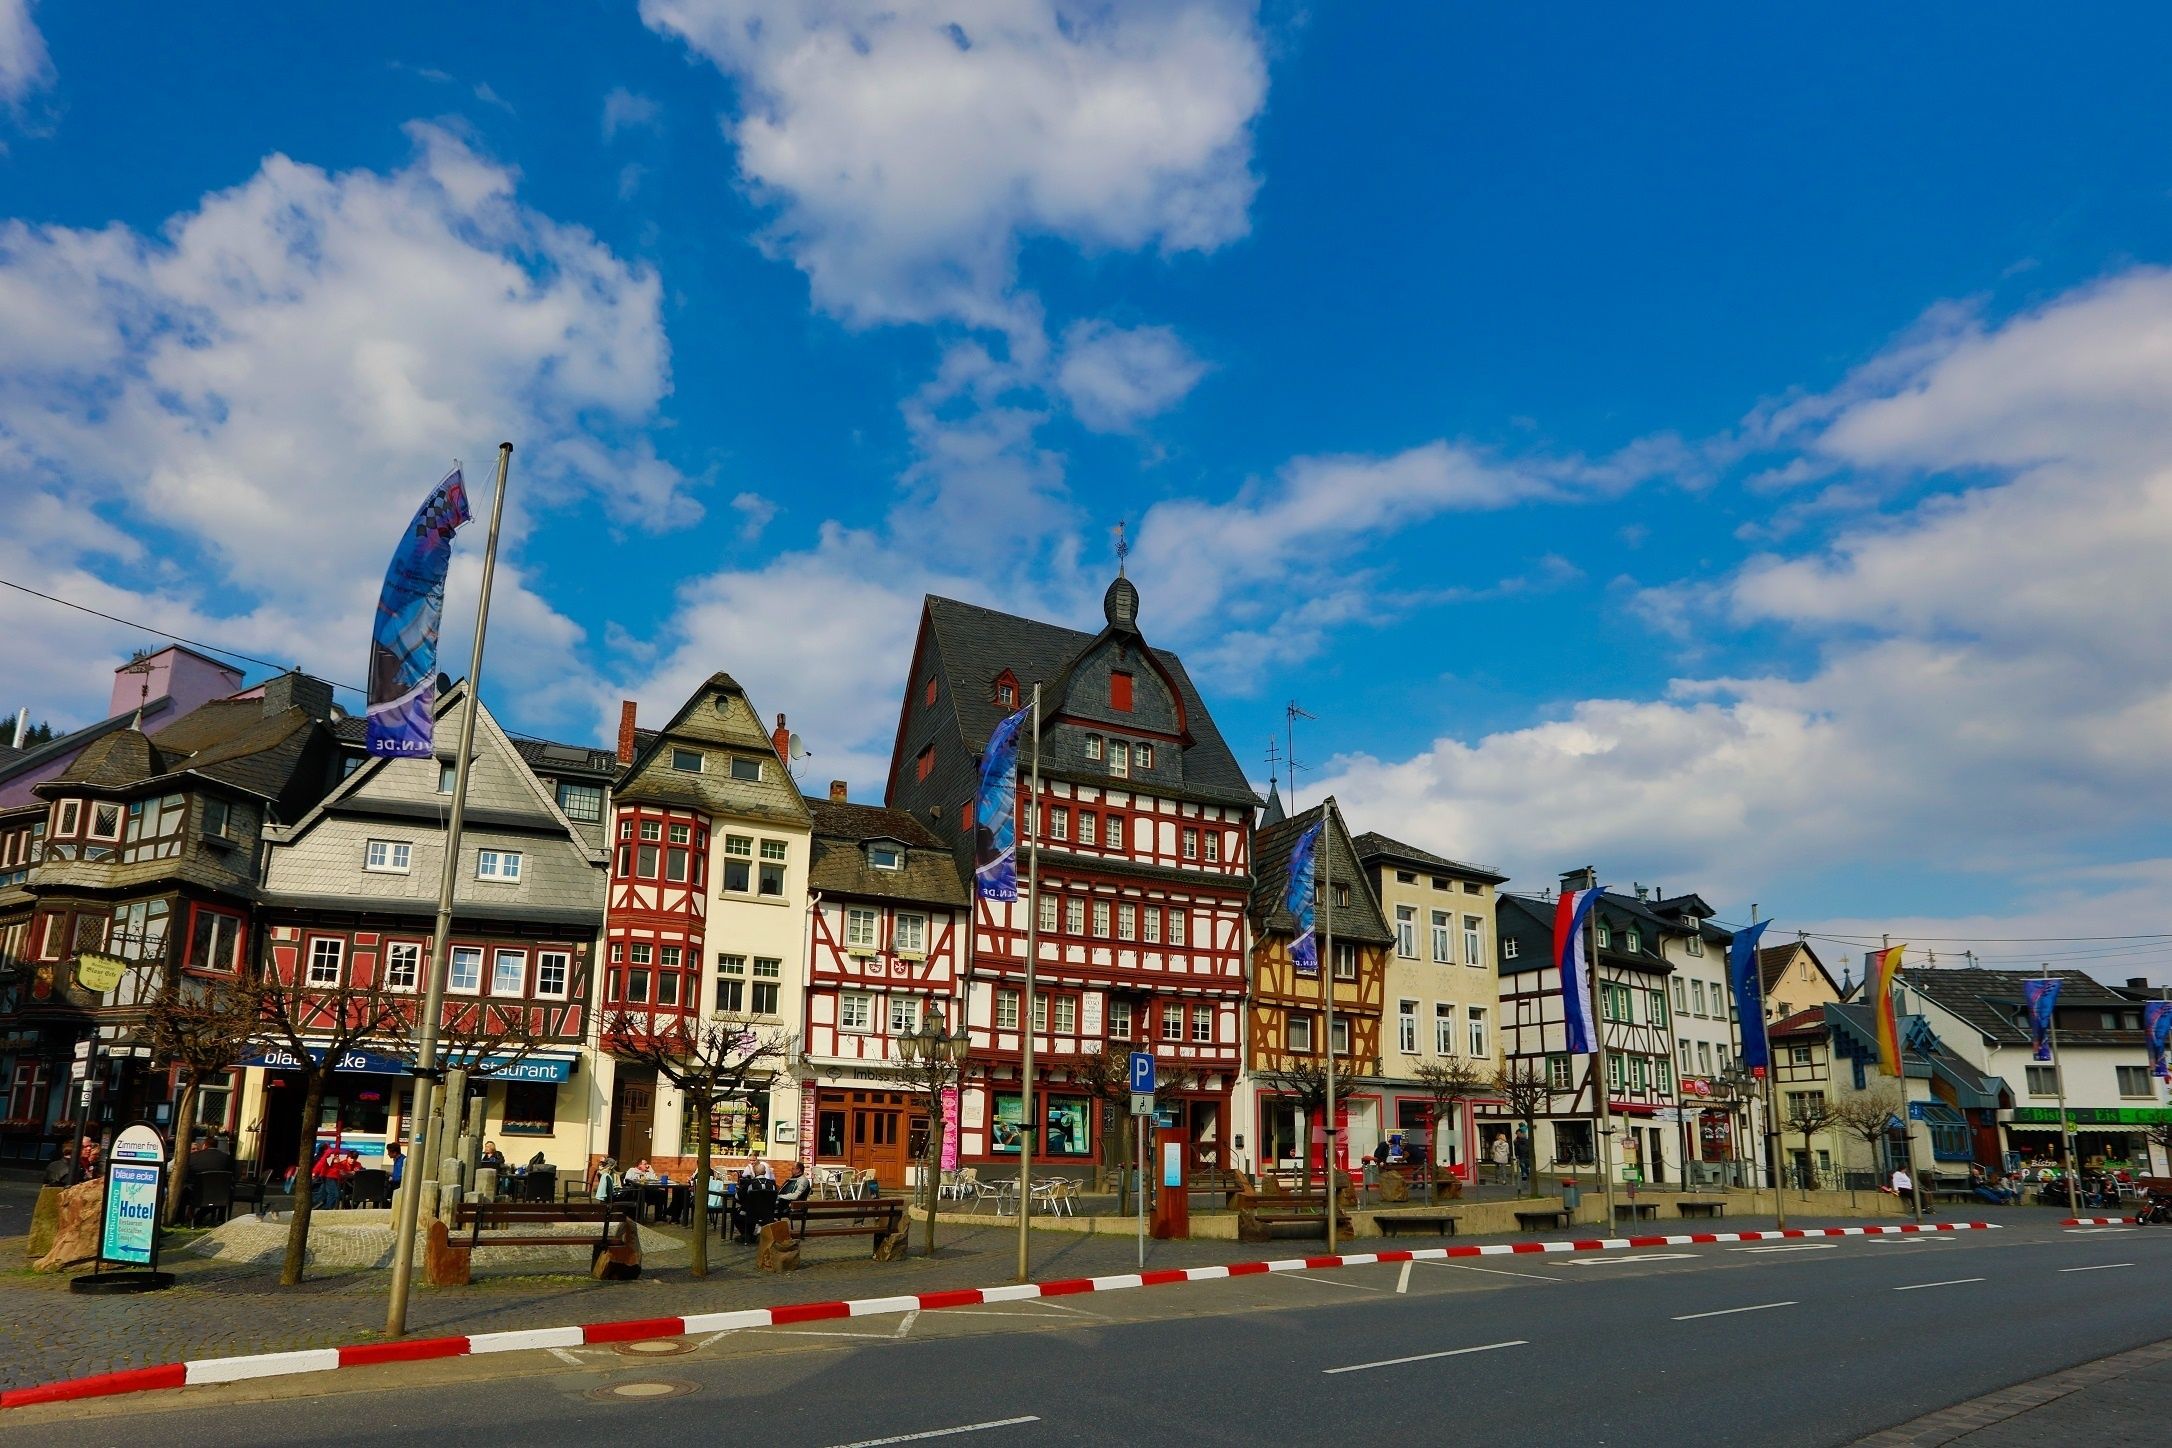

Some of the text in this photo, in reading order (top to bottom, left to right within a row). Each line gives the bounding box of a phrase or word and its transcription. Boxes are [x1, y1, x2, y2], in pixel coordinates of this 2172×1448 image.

[464, 1061, 558, 1079] staurant
[854, 1068, 890, 1082] Imbiss
[1136, 1057, 1149, 1087] P
[2032, 1109, 2077, 1121] Bisto
[2095, 1109, 2117, 1121] Eis
[117, 1140, 158, 1150] Zimmer frei
[115, 1169, 154, 1181] blaue ecke
[120, 1201, 154, 1219] Hotel
